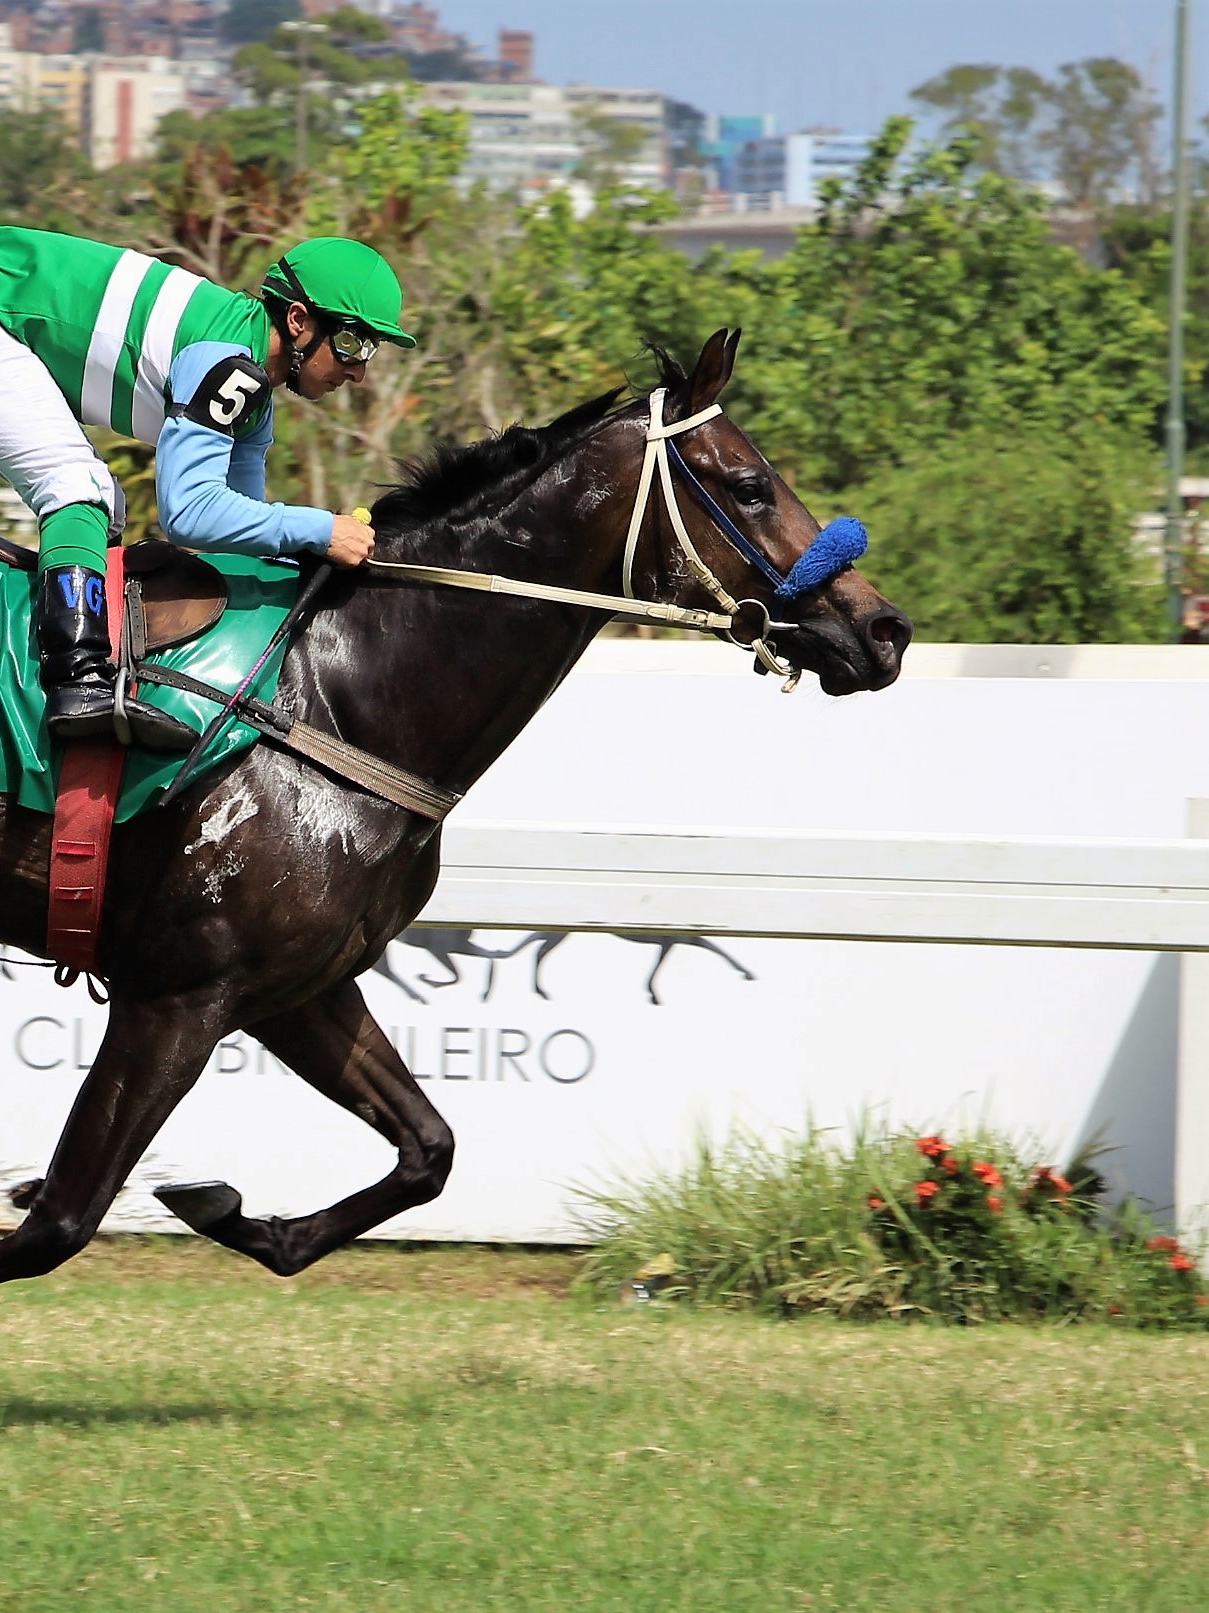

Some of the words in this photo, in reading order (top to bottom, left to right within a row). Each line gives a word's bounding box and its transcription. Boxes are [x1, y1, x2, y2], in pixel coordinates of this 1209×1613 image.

[208, 368, 262, 426] 5
[57, 571, 104, 617] VG
[14, 1015, 93, 1071] CL
[215, 1026, 596, 1084] BLEIRO
